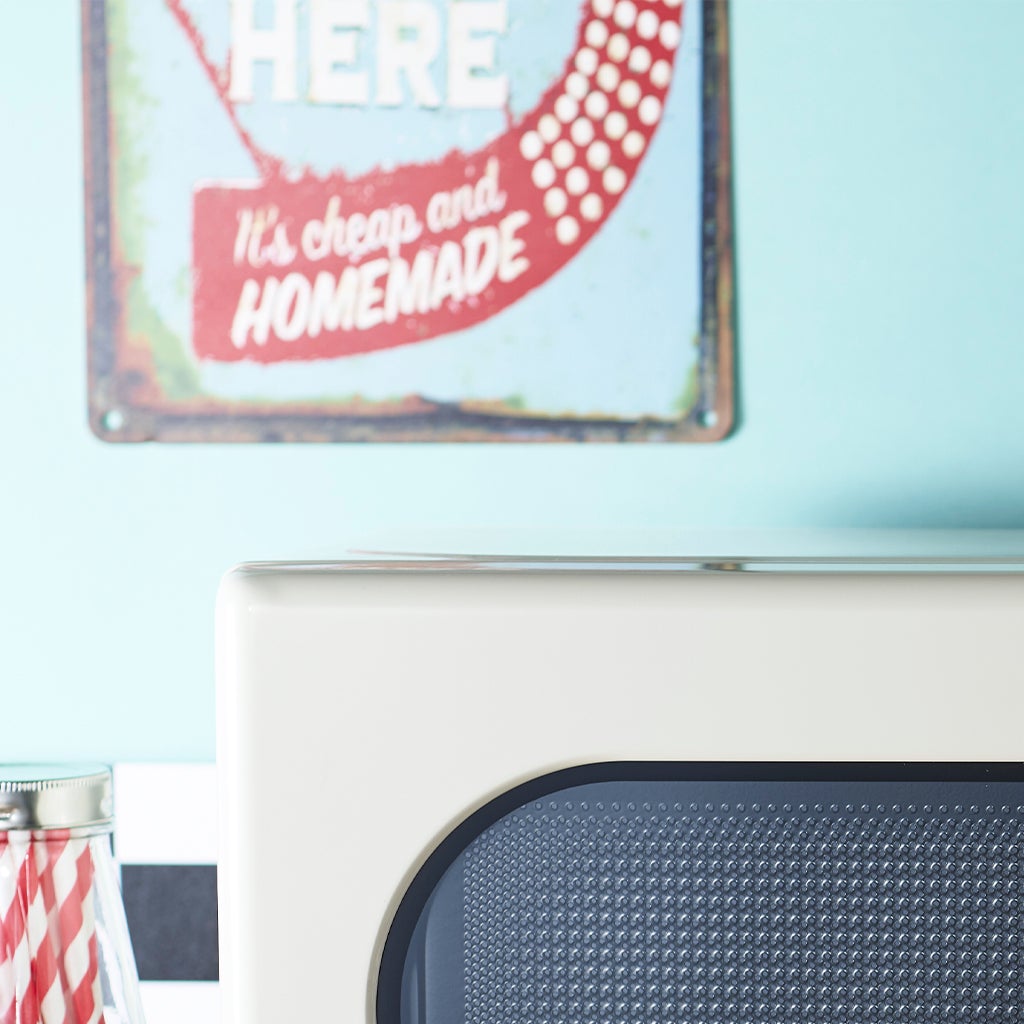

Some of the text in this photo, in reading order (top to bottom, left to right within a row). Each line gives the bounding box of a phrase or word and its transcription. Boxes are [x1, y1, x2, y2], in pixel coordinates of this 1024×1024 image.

[228, 0, 507, 109] HERE
[233, 155, 507, 268] It's cheap and
[229, 209, 531, 349] HOMEMADE
